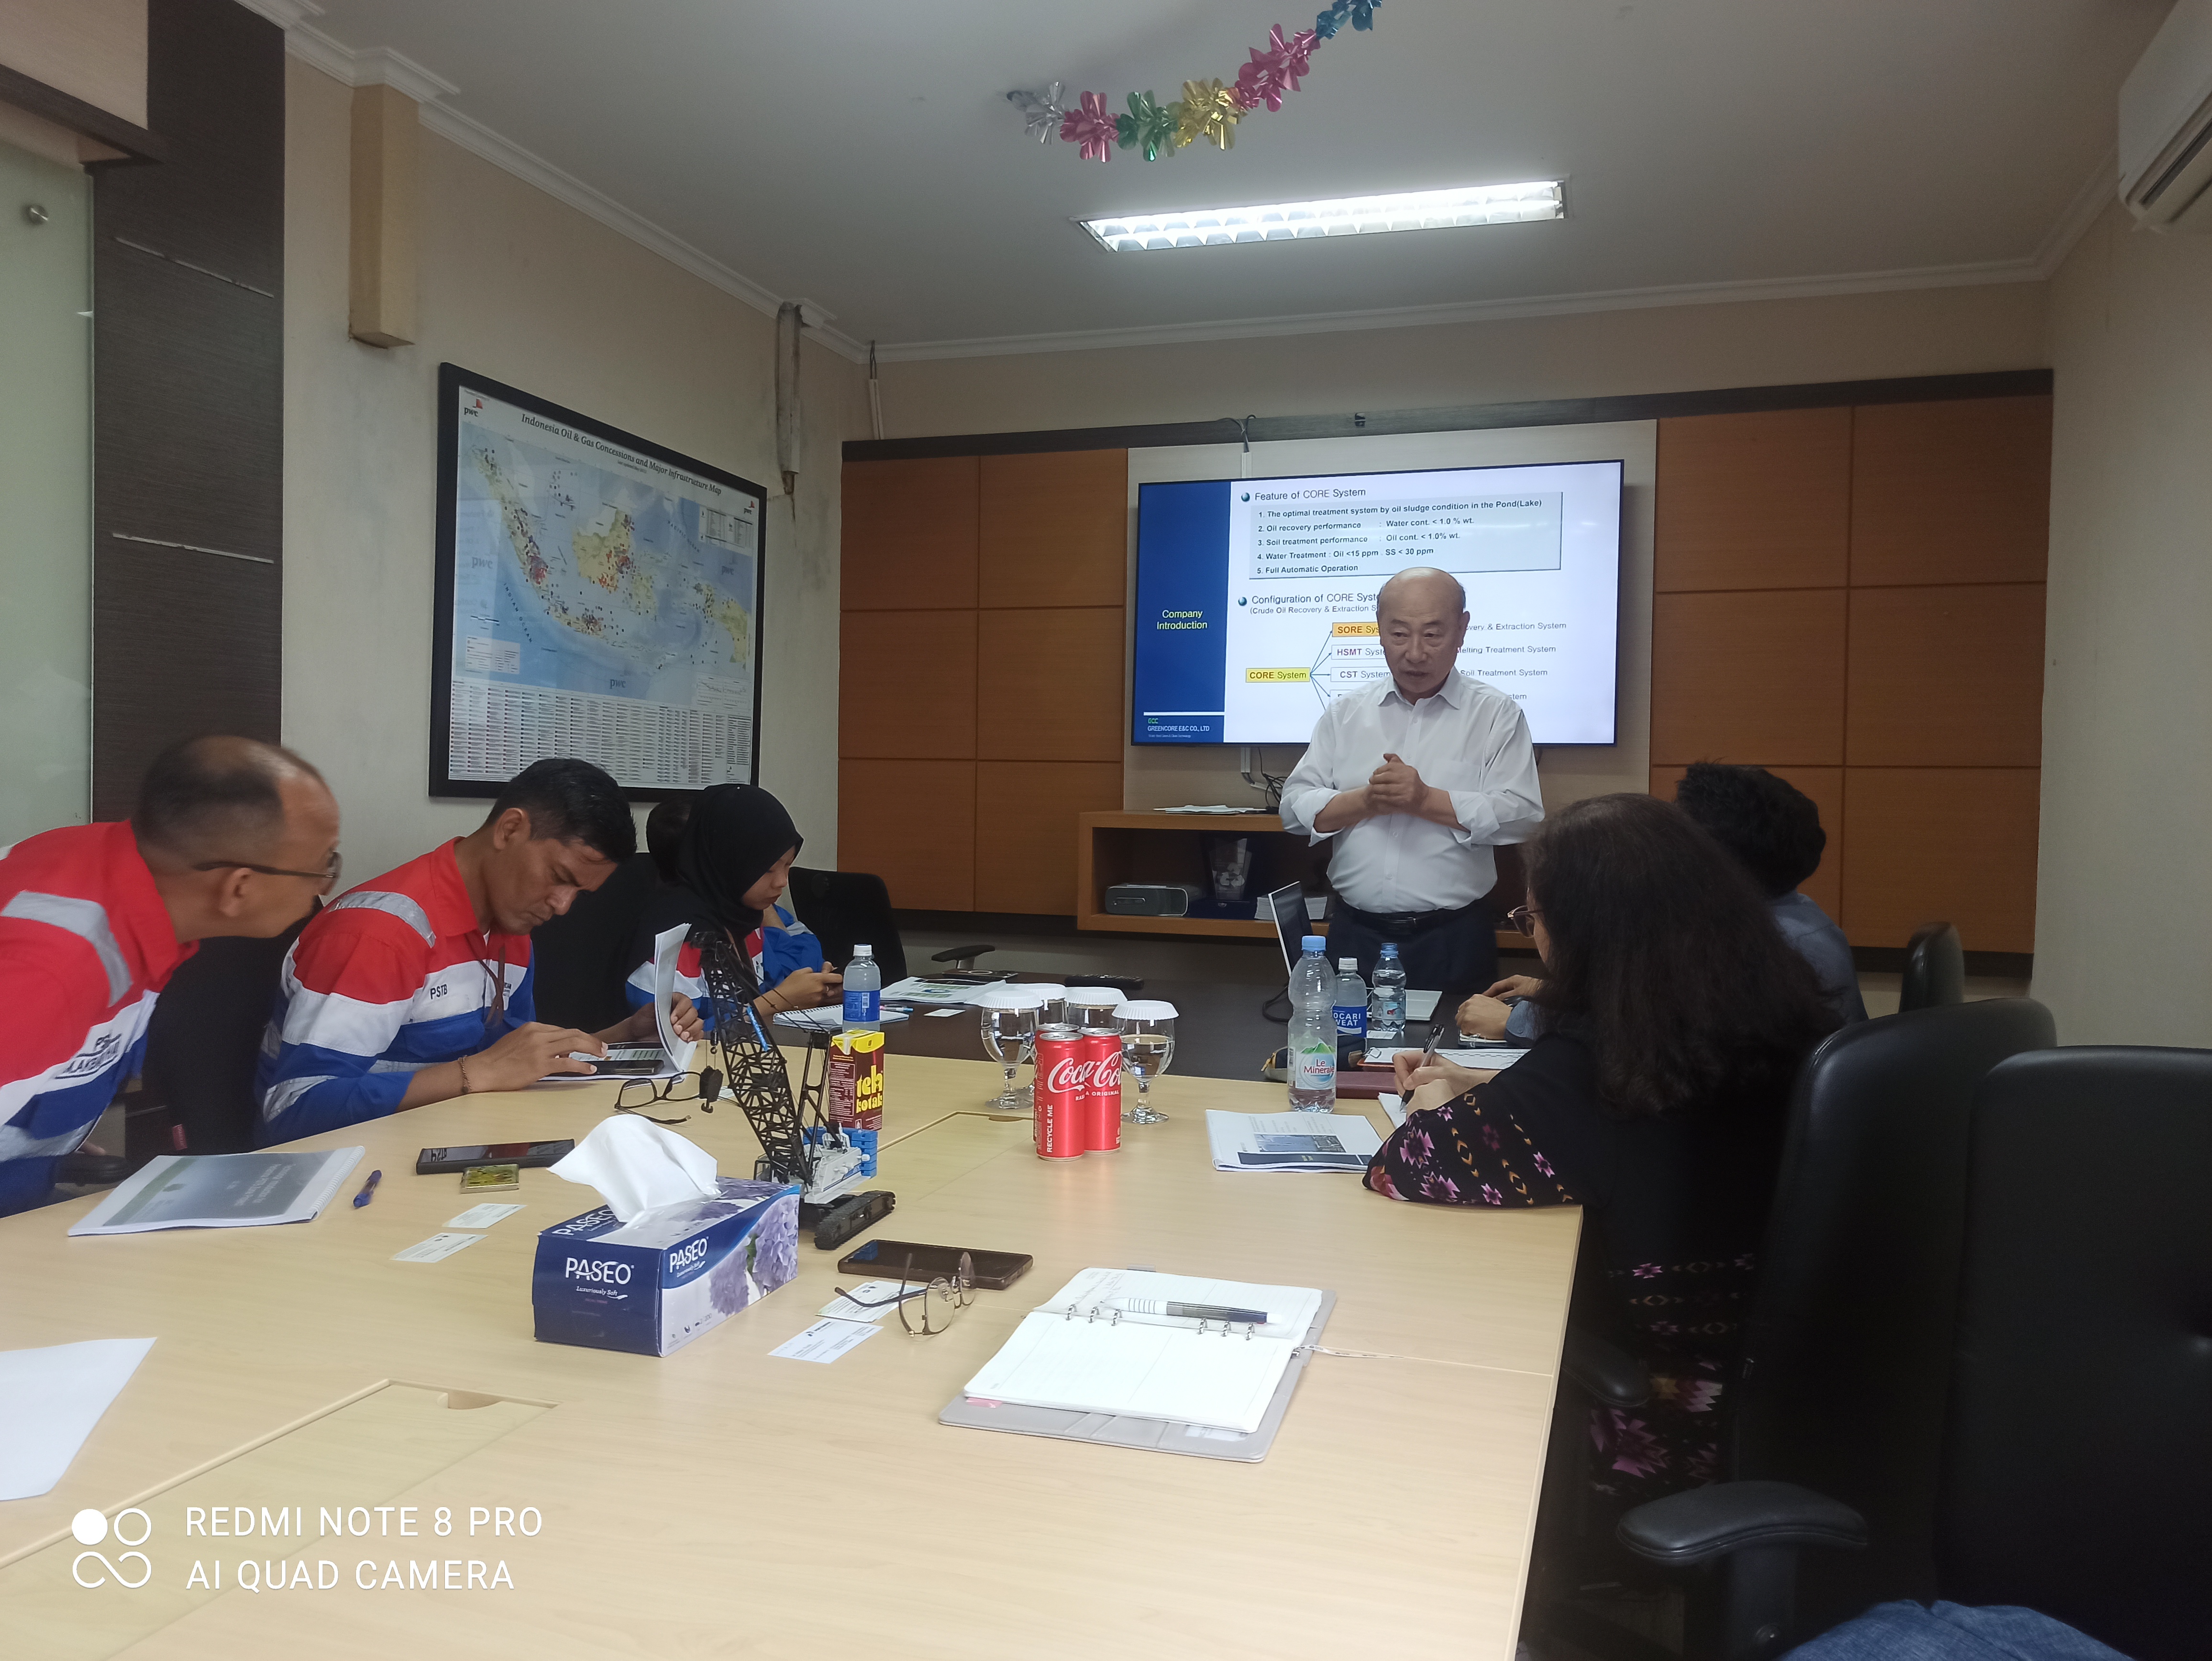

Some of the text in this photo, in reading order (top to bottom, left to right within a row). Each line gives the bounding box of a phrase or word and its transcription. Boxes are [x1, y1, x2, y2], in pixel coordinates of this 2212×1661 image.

[464, 407, 478, 417] pwc
[521, 413, 721, 496] Indonesia Oil & Gas Concessions and Major Infrastructure Map
[1255, 488, 1366, 501] Feature of CORE System
[1283, 509, 1310, 518] optimal
[1350, 507, 1378, 516] system
[1380, 506, 1390, 514] by
[1404, 504, 1429, 513] sludge
[1496, 499, 1542, 508] Pond(Lake)
[1279, 524, 1311, 532] recovery
[1314, 522, 1361, 531] performance
[1320, 536, 1368, 545] performance
[472, 556, 494, 569] pwc
[1321, 565, 1358, 573] Operation
[1252, 593, 1379, 604] Configuration of CORE Syst
[1162, 609, 1203, 620] Company
[1157, 620, 1208, 630] Introduction
[1366, 625, 1379, 634] Sys
[1537, 622, 1567, 631] System
[1527, 645, 1556, 653] System
[1250, 670, 1307, 681] CORE System
[1360, 670, 1391, 679] System
[1519, 669, 1548, 677] System
[609, 679, 626, 689] pwc
[430, 984, 448, 1000] PSTB
[1316, 1059, 1326, 1067] Le
[1304, 1065, 1335, 1074] Minerale
[856, 1065, 883, 1097] teh
[856, 1093, 883, 1114] kotak
[1047, 1104, 1053, 1117] ME
[552, 1209, 615, 1236] PASEO
[670, 1238, 708, 1273] PASEO
[565, 1257, 631, 1285] PASEO
[575, 1285, 607, 1296] Luxuriously
